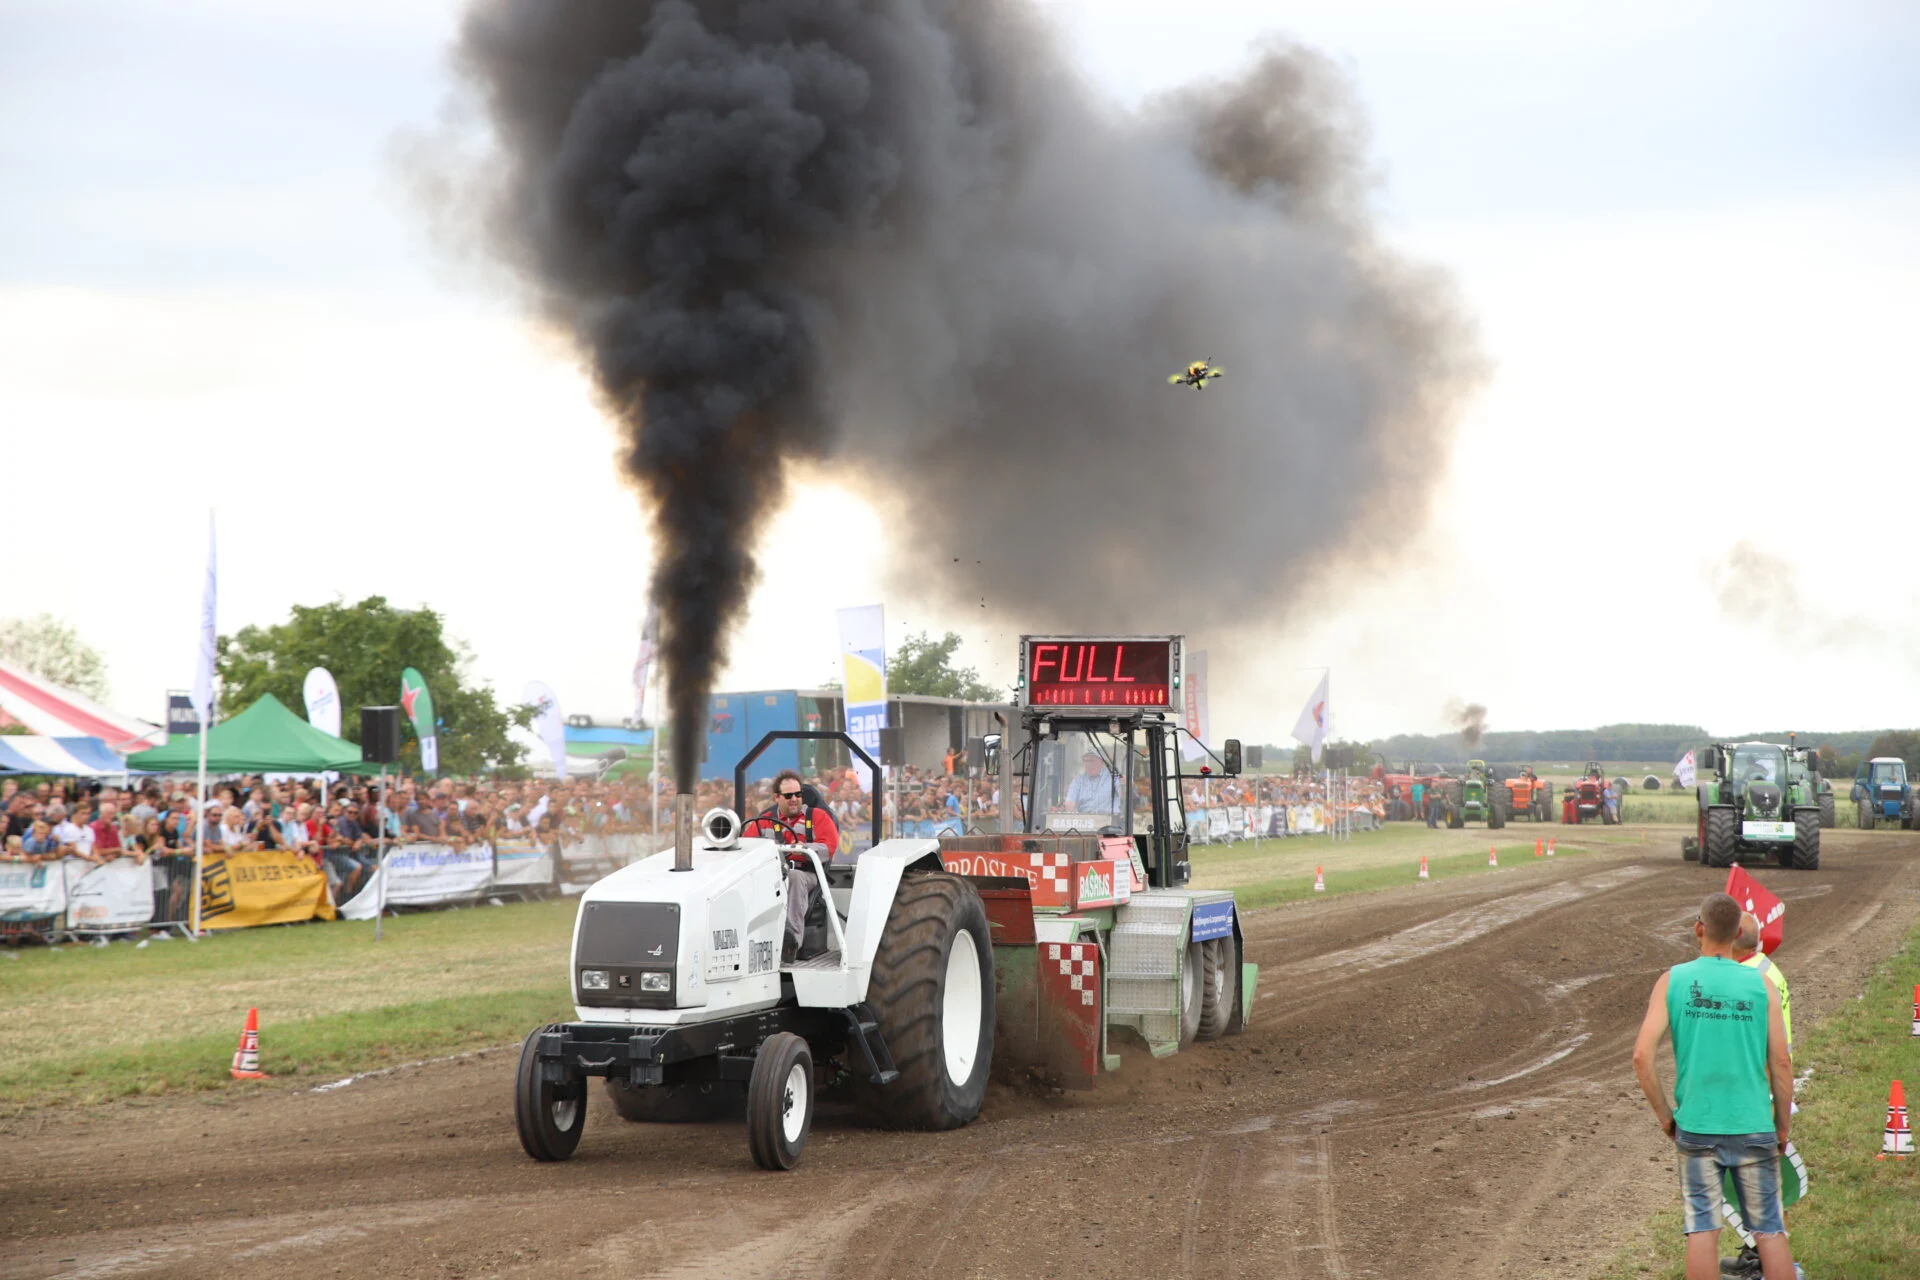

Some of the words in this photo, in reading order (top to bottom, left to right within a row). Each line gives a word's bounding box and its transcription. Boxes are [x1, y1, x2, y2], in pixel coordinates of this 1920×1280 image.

[1032, 645, 1136, 682] FULL
[712, 928, 740, 951] VALTRA
[1685, 1009, 1754, 1022] Hyproslee-team
